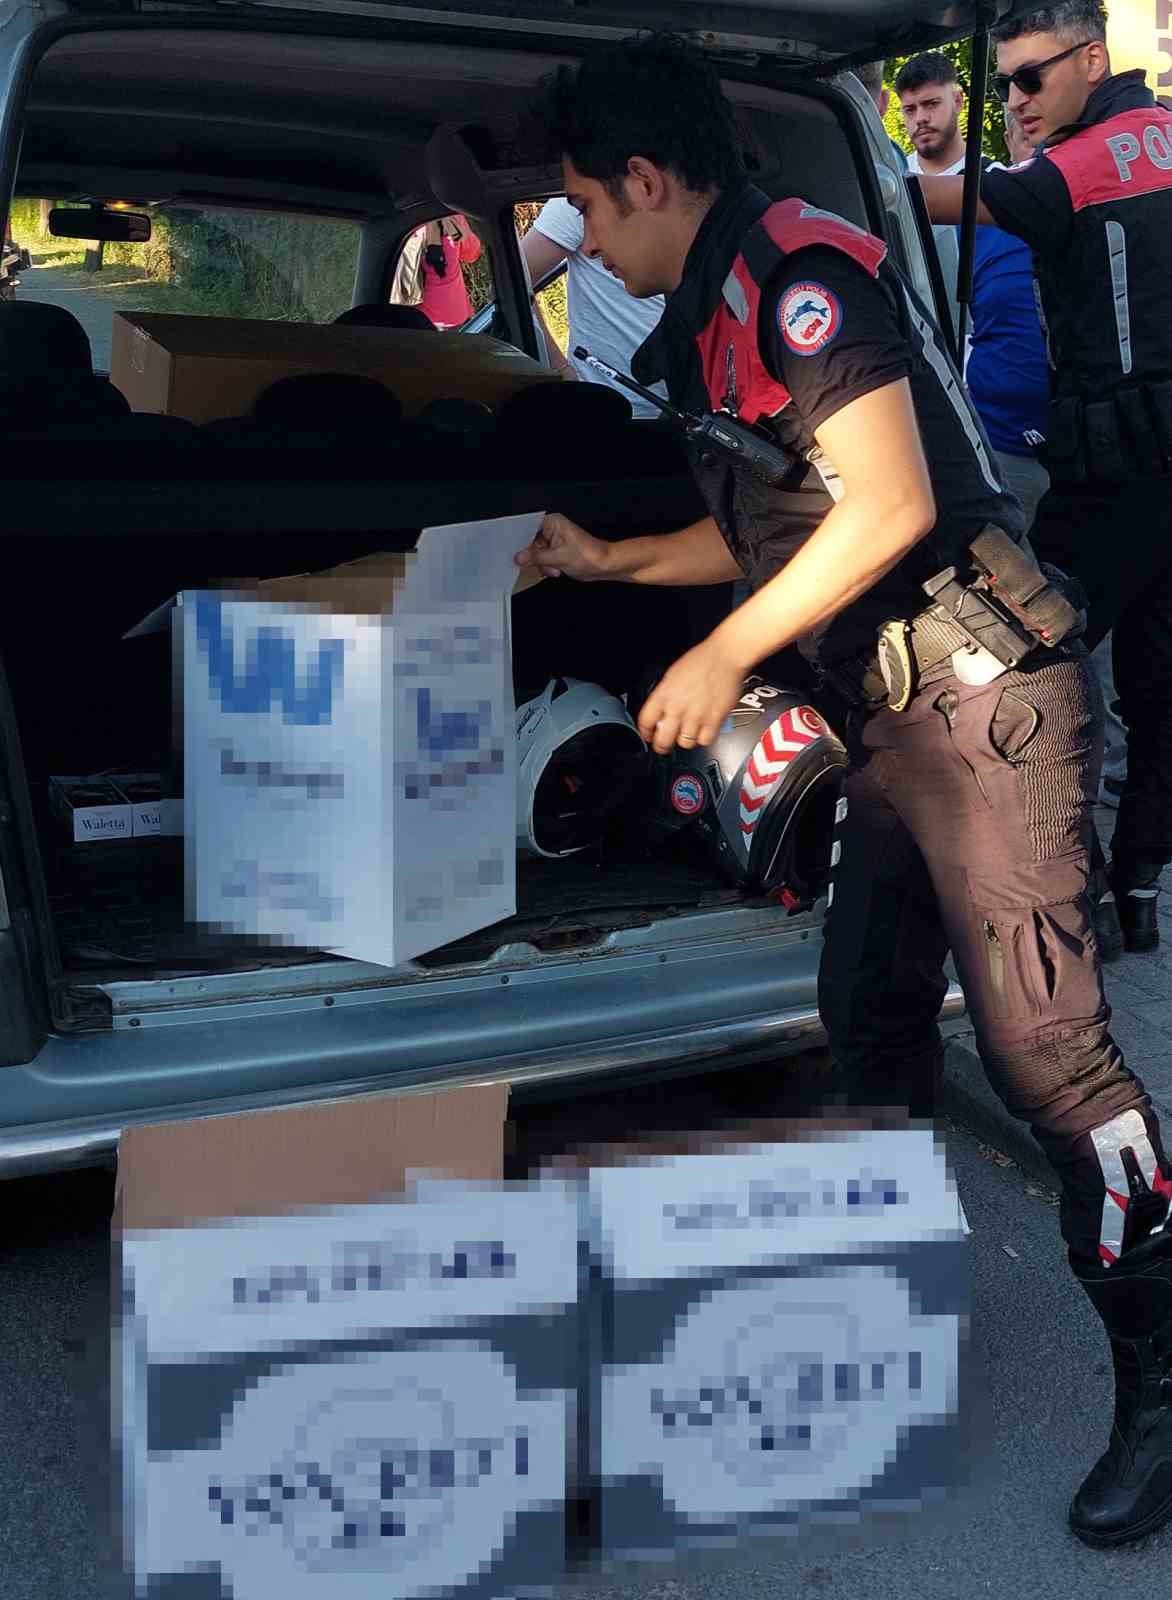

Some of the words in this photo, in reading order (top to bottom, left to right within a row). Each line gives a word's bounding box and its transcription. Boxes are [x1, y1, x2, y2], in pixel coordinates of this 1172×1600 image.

[1105, 124, 1172, 182] PO
[740, 685, 779, 708] PO
[81, 818, 125, 831] Waletta
[140, 813, 161, 825] Wal
